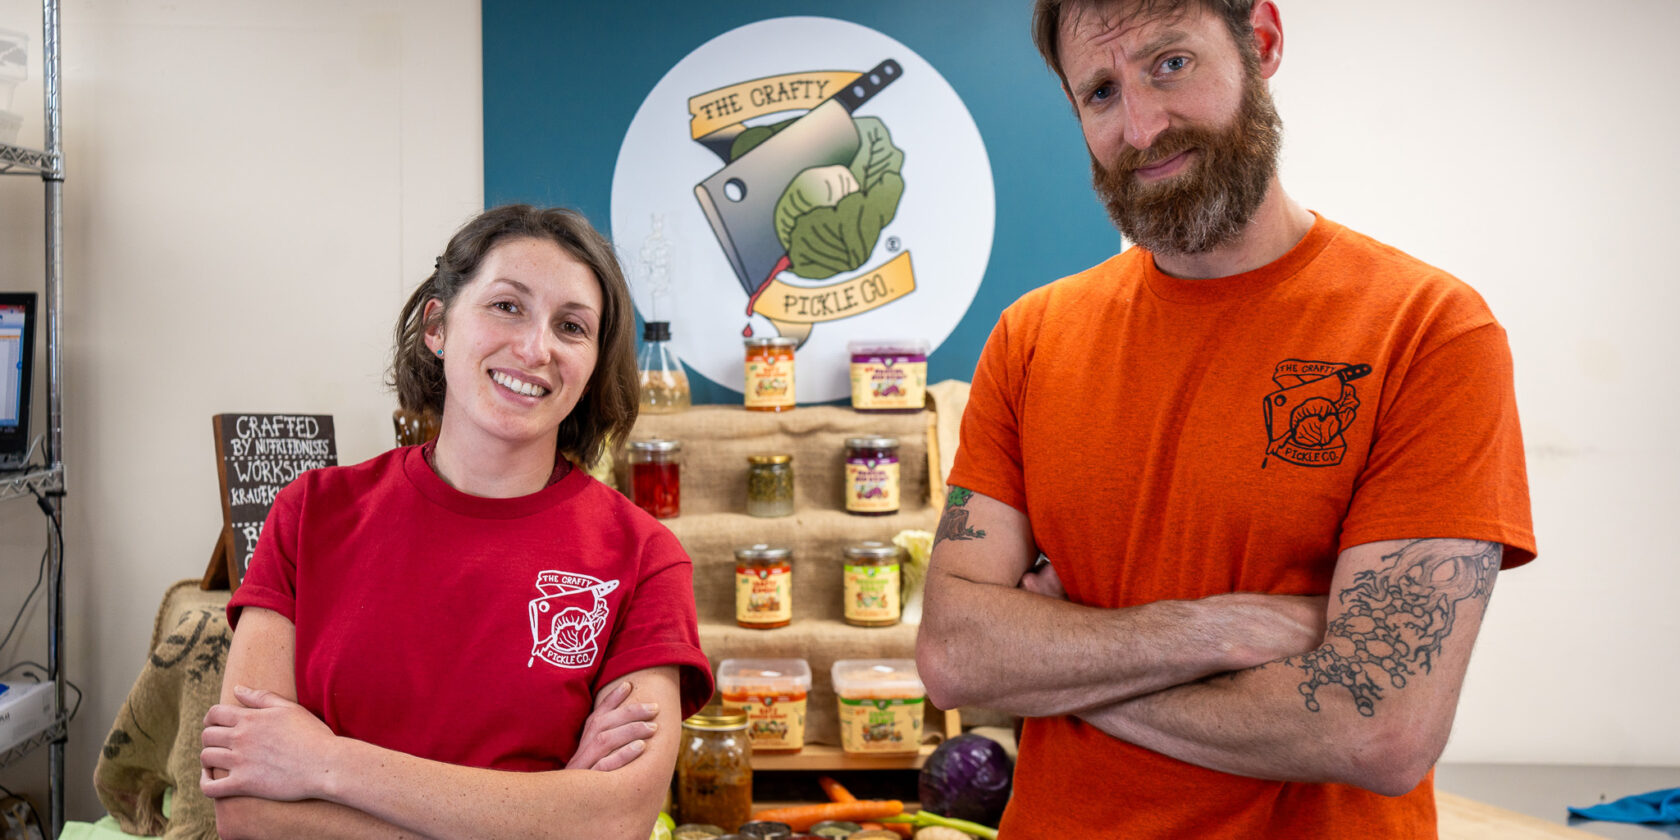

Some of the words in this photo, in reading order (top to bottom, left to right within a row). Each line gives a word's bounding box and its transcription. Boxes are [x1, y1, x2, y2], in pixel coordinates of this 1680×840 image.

[700, 93, 743, 120] THE
[750, 80, 829, 107] CRAFTY
[784, 286, 858, 316] PICKLE
[861, 274, 894, 303] CO.
[1280, 364, 1298, 372] THE
[1302, 365, 1336, 374] CRAFTY
[236, 416, 319, 438] CRAFTED
[231, 438, 252, 456] BY
[255, 439, 329, 456] NUTRITIONISTS
[1285, 448, 1320, 462] PICKLE
[1321, 451, 1339, 461] CO.
[543, 575, 559, 583] THE
[561, 577, 592, 588] CRAFTY
[547, 651, 575, 664] PICKLE
[576, 654, 590, 664] CO.
